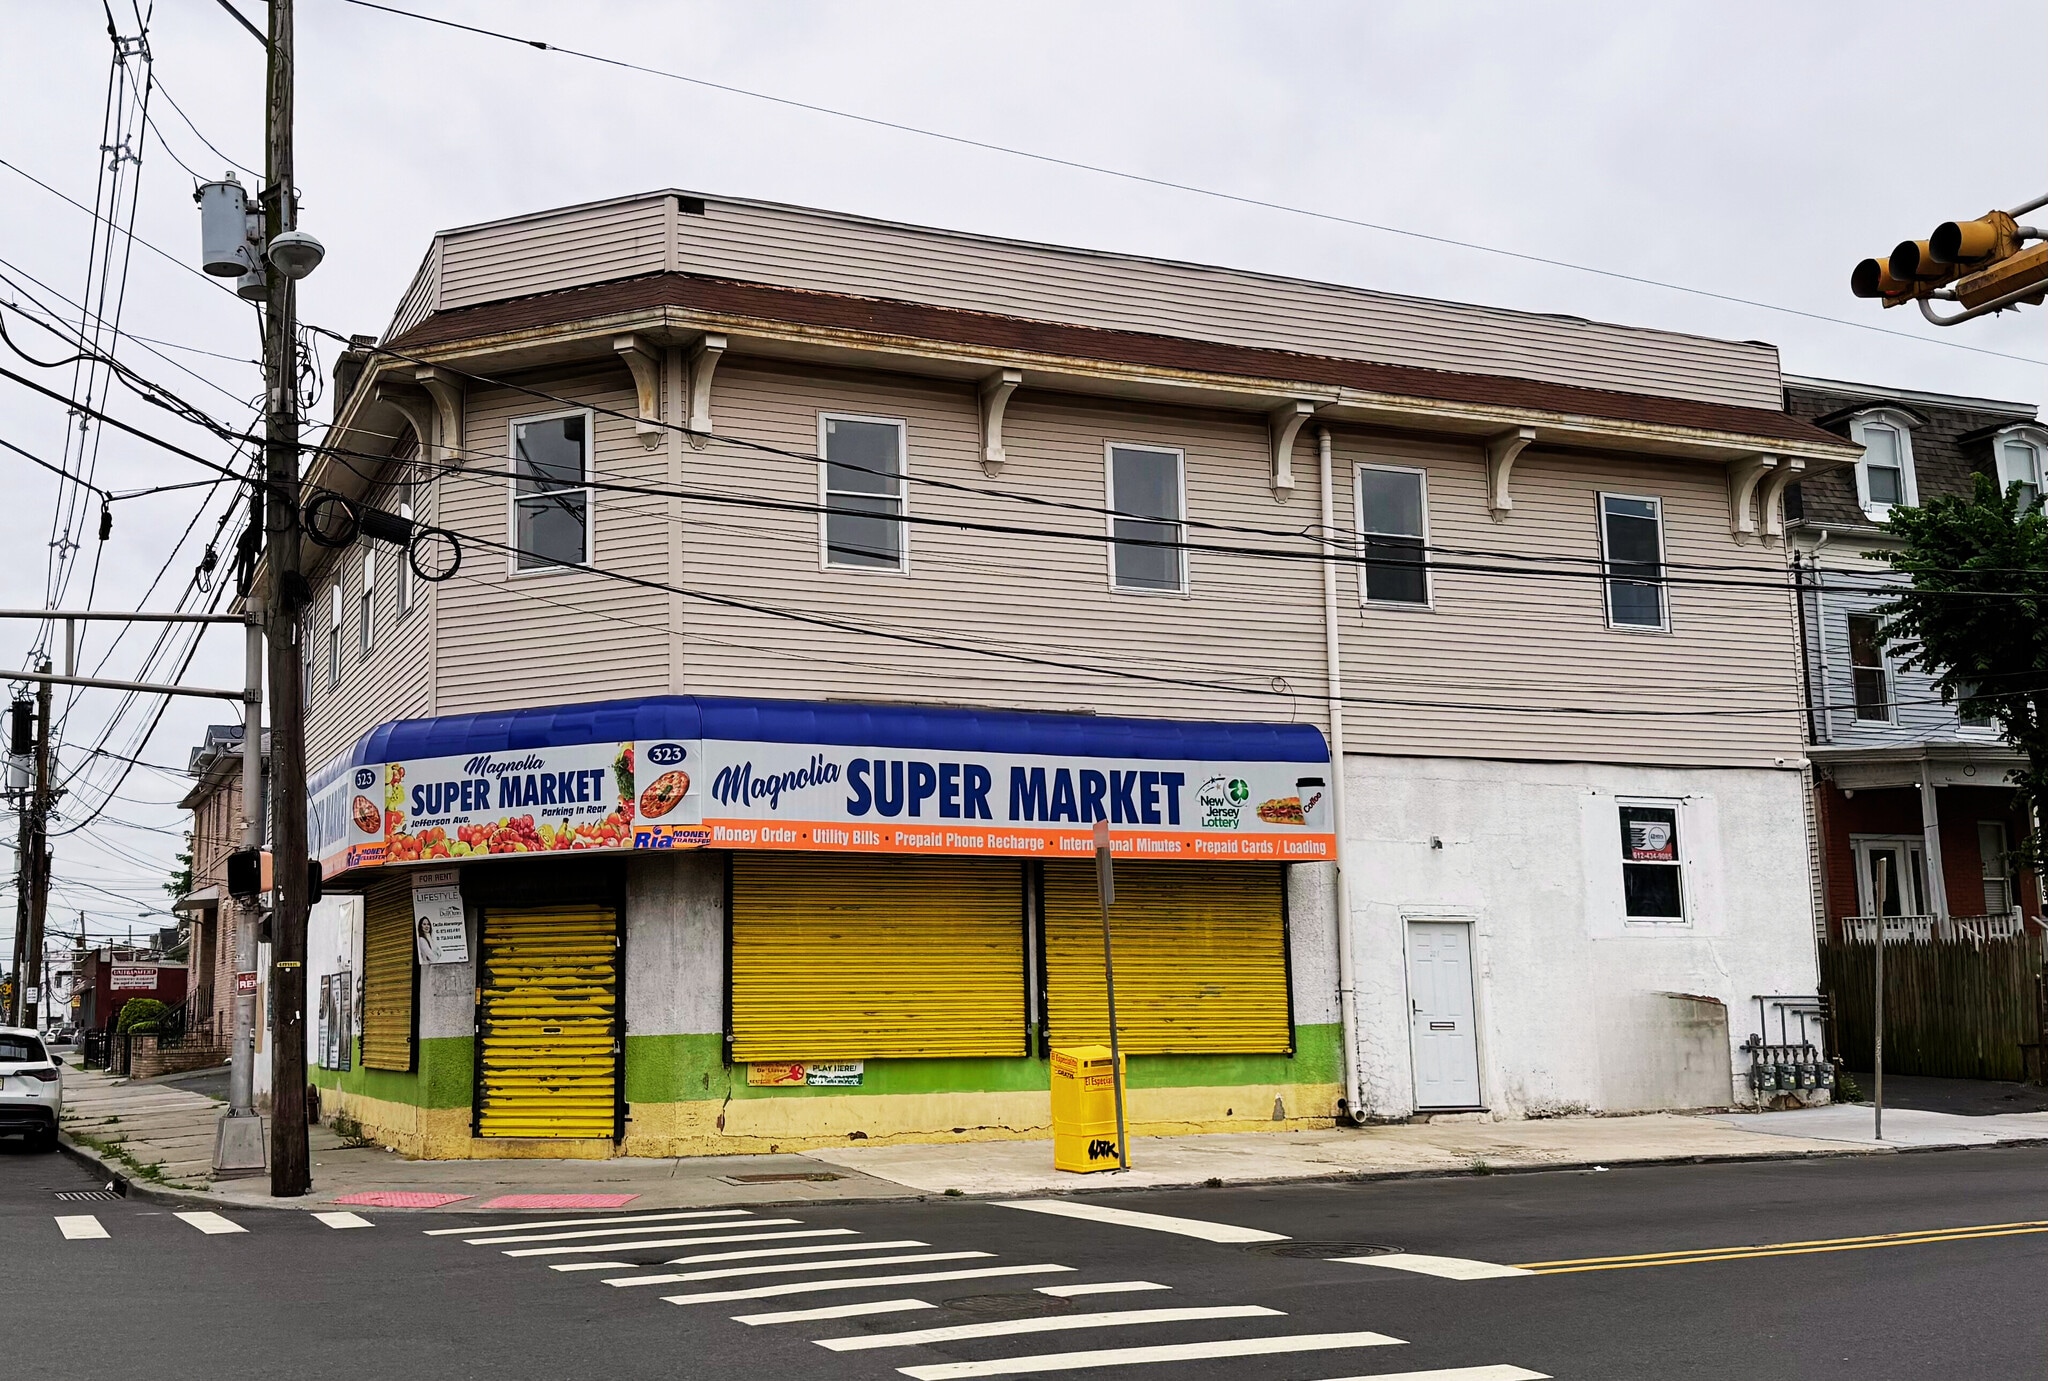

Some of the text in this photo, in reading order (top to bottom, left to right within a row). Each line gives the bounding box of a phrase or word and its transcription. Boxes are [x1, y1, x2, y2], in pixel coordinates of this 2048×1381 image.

[653, 747, 682, 761] 323
[463, 753, 546, 780] Magnolia
[356, 772, 373, 787] 323
[711, 753, 842, 810] Magnolia
[411, 769, 605, 817] SUPER MARKET
[846, 758, 1186, 826] SUPER MARKET
[1200, 795, 1225, 807] New
[541, 804, 607, 817] Parking In Rear
[1206, 807, 1240, 819] Jersey
[411, 815, 471, 828] Jefferson Ave.
[1202, 817, 1240, 829] Lottery
[633, 825, 674, 849] Ria
[673, 830, 711, 838] MONEY
[713, 826, 757, 843] Money
[761, 827, 797, 843] Order
[812, 829, 849, 846] Utility
[853, 830, 880, 846] Bills
[895, 831, 943, 848] Prepaid
[946, 833, 982, 848] Phone
[987, 834, 1045, 851] Recharge
[1059, 836, 1133, 852] Internonal
[1137, 838, 1181, 853] Minutes
[1195, 839, 1238, 855] Prepaid
[1241, 839, 1274, 854] Cards
[1283, 840, 1327, 855] Loading
[418, 872, 453, 883] FOR RENT
[416, 891, 459, 902] LIFESTYLE
[812, 1064, 833, 1072] PLAY
[1092, 1075, 1113, 1087] Especial
